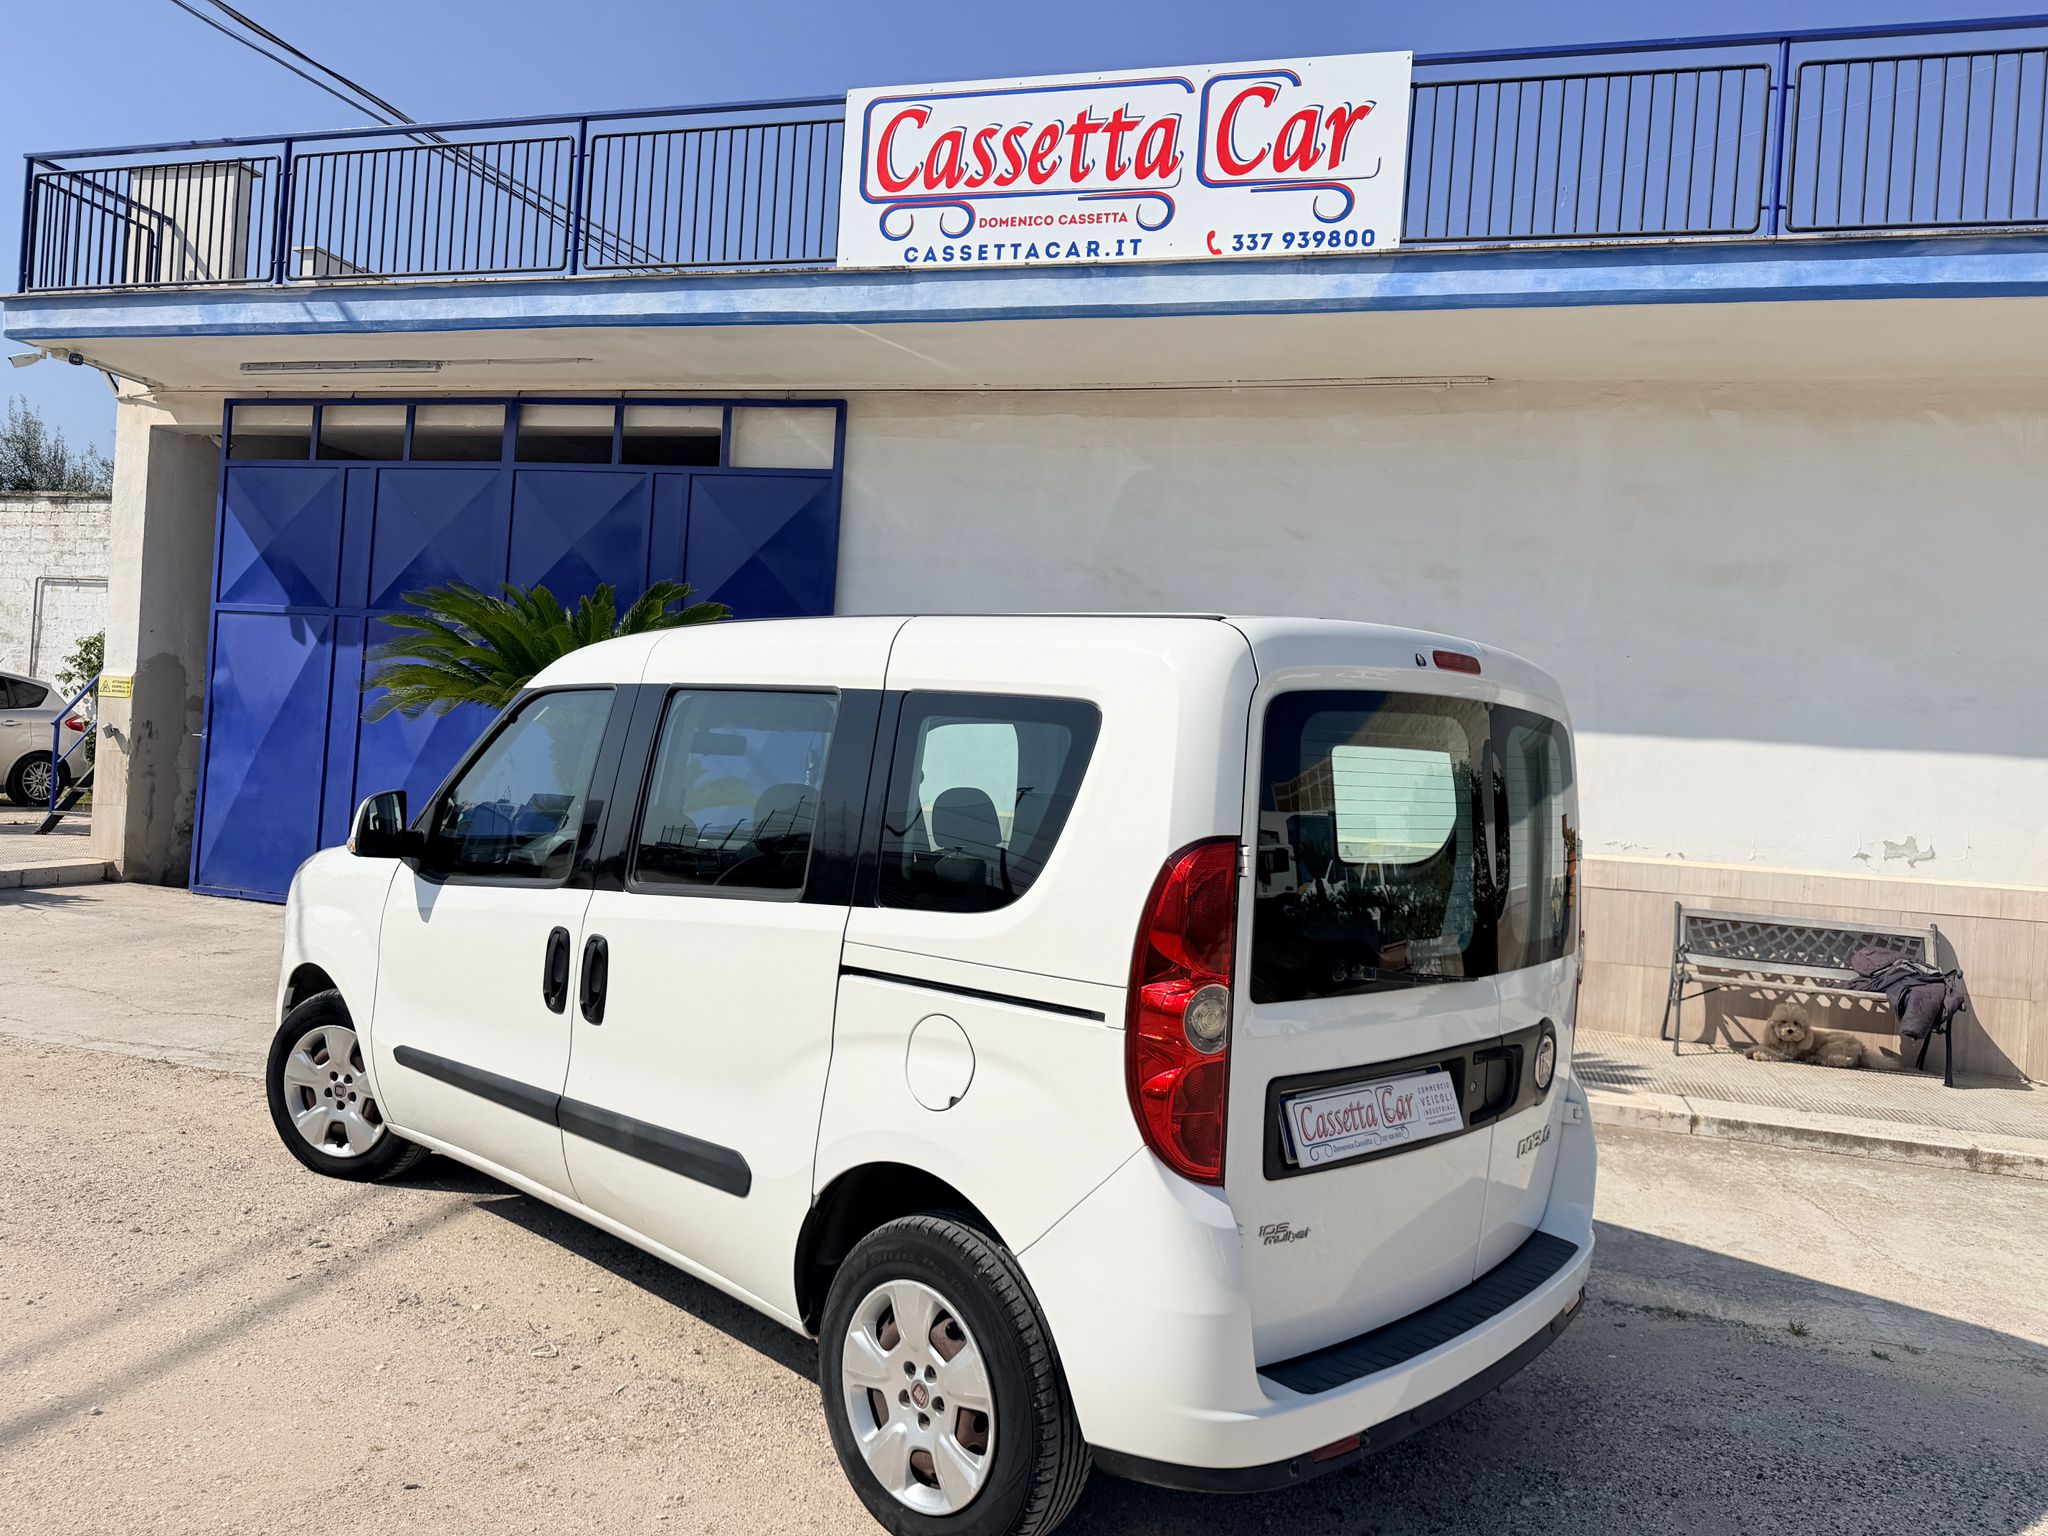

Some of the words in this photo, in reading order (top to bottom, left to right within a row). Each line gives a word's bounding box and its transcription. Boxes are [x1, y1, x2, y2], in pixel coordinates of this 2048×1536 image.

[877, 102, 1184, 193] Cassetta
[1215, 82, 1377, 176] Car
[979, 215, 1054, 228] DOMENICO
[1058, 212, 1128, 226] CASSETTA
[1231, 232, 1274, 252] 337
[1281, 229, 1376, 250] 939800
[903, 238, 1143, 263] CASSETTACAR.IT
[1417, 1082, 1450, 1094] COMMERCIO
[1420, 1092, 1453, 1106] VEICOLI
[1301, 1100, 1378, 1141] Cassetta
[1382, 1088, 1413, 1123] Car
[1424, 1104, 1455, 1116] INDUSTRIALI
